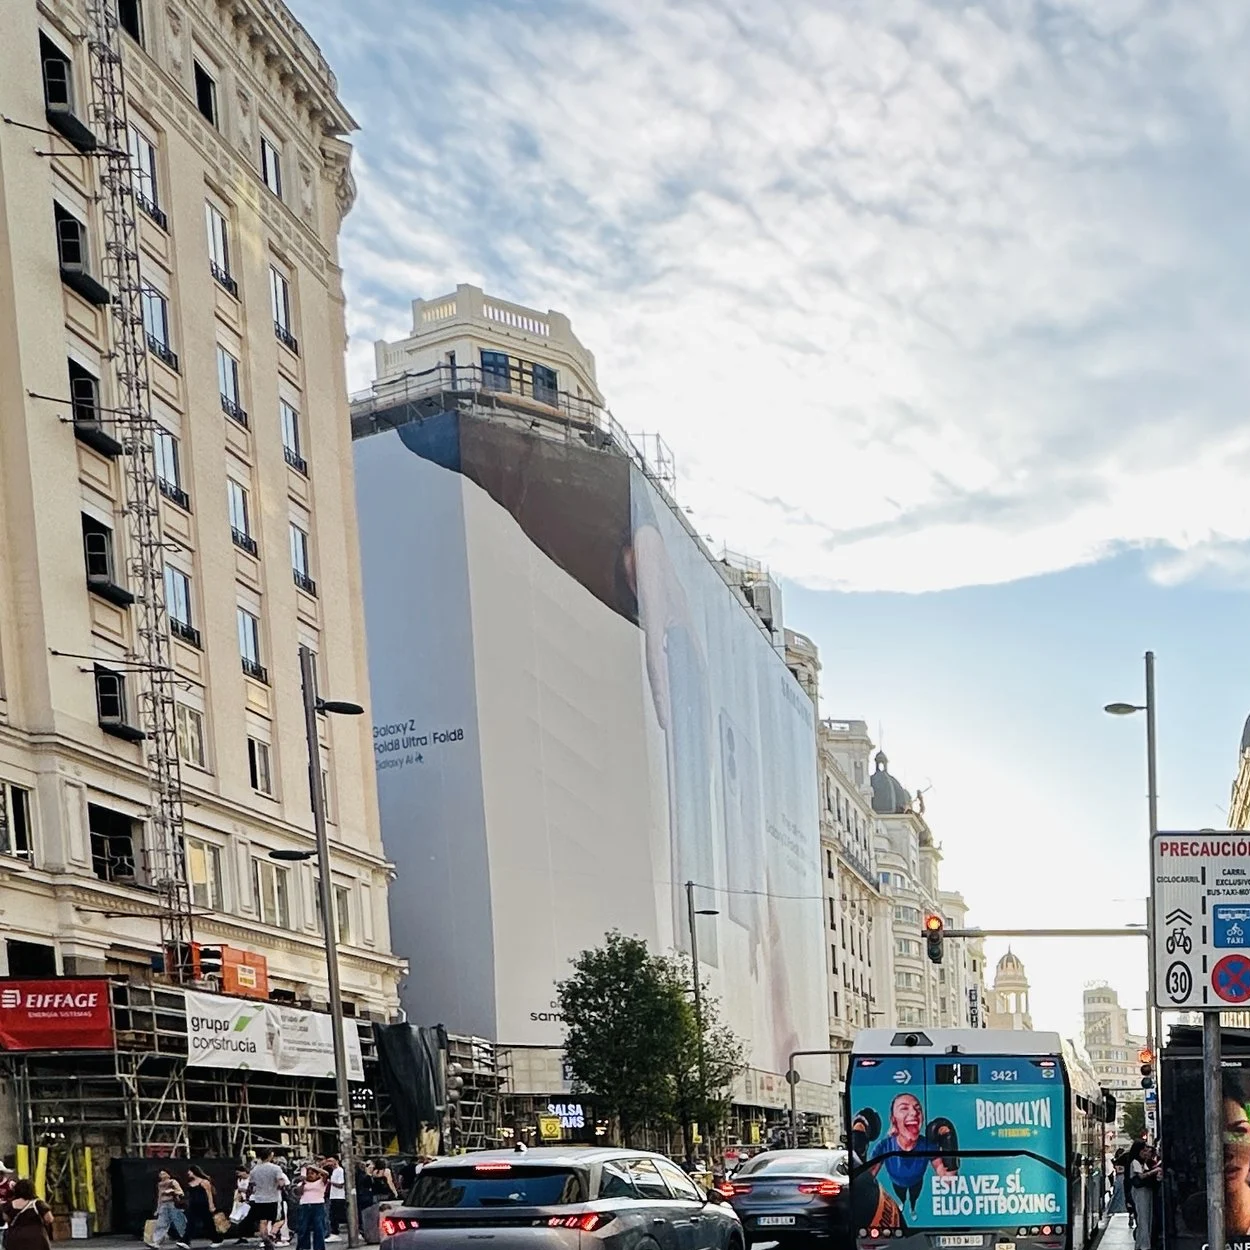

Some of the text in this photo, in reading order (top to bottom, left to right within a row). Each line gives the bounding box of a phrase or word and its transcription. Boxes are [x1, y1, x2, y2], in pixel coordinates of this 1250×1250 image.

[372, 719, 416, 738] Galaxy Z
[374, 728, 464, 754] Fold8 Ultra Fold8
[1156, 876, 1200, 884] CICLOCARRIL
[1222, 868, 1247, 876] CARRIL
[1171, 971, 1187, 994] 30
[26, 993, 99, 1008] EIFFAGE
[191, 1016, 230, 1034] grupo
[990, 1070, 1019, 1081] 3421
[547, 1103, 584, 1116] SALSA
[975, 1096, 1052, 1131] BROOKLYN
[560, 1116, 585, 1128] ANS
[931, 1167, 1025, 1197] ESTA VEZ, SÍ.
[932, 1193, 1061, 1216] ELIJO FITBOXING.
